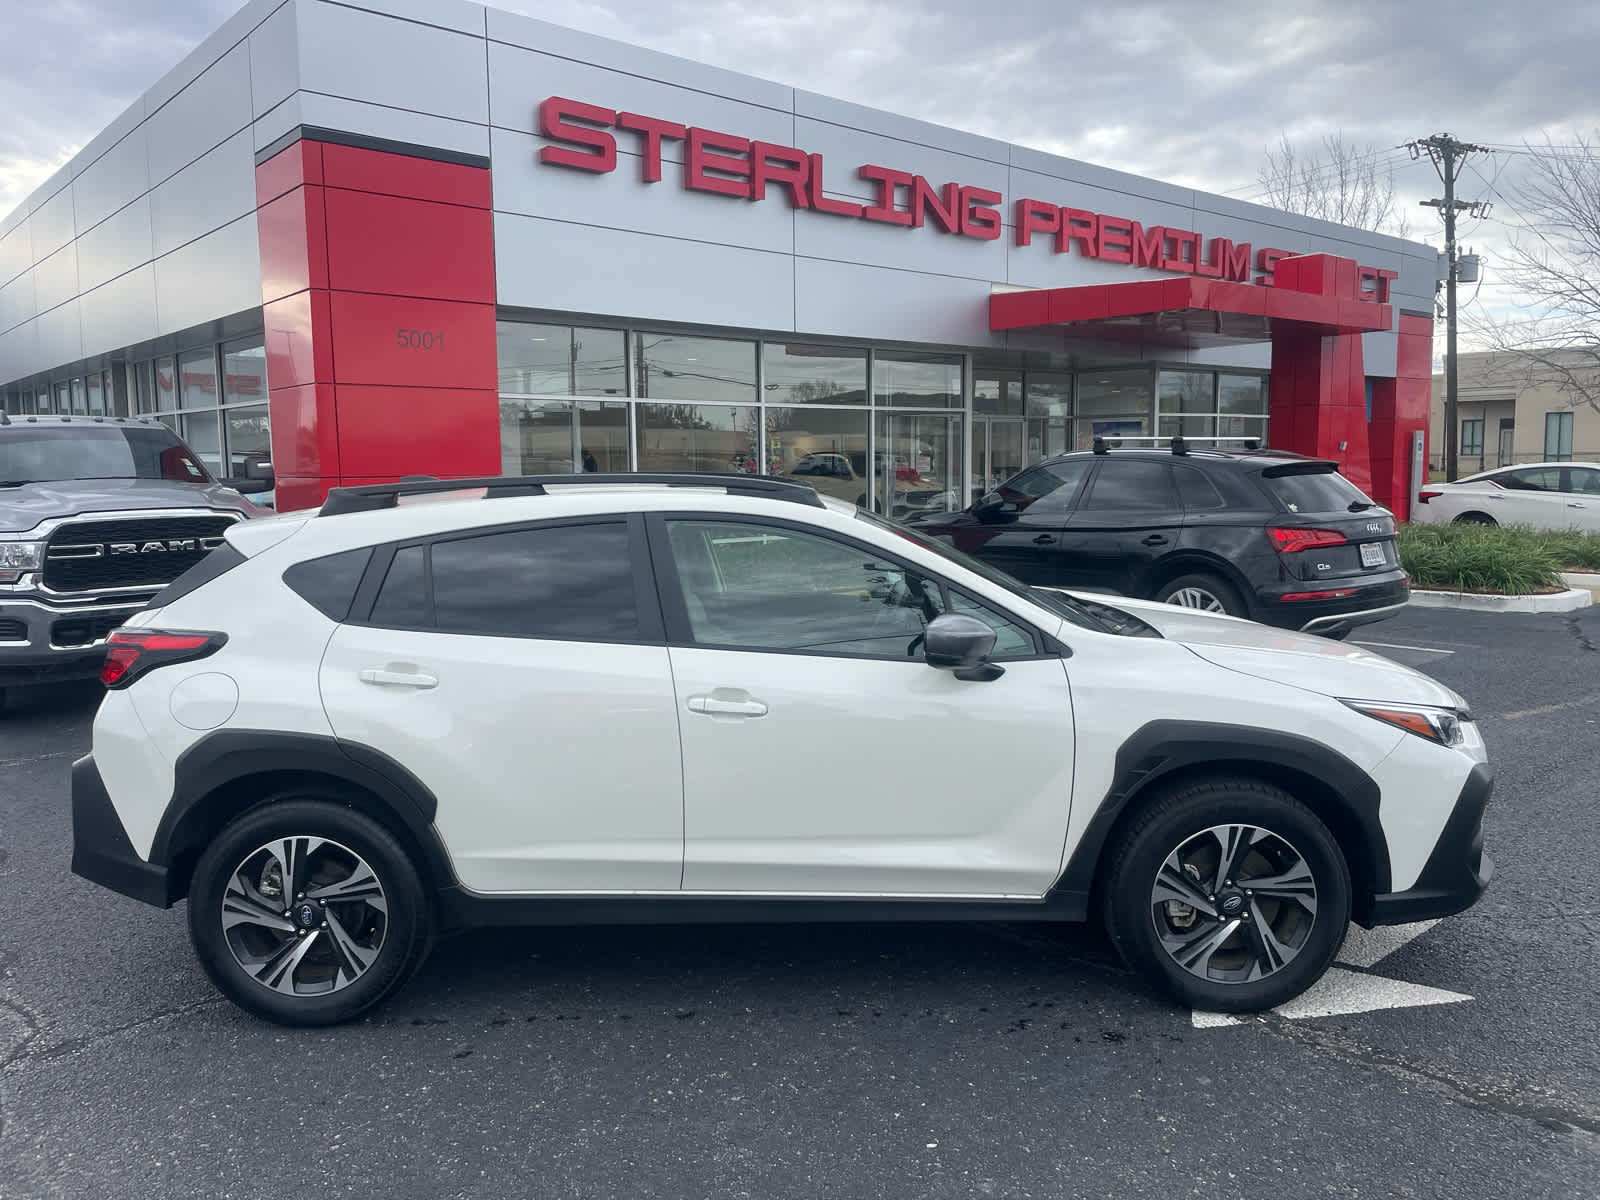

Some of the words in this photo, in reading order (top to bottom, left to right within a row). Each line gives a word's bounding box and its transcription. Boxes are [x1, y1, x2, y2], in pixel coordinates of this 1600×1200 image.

[539, 96, 1001, 241] STERLING
[1016, 198, 1252, 282] PREMIUM
[397, 328, 444, 350] 5001
[110, 540, 195, 555] RAM
